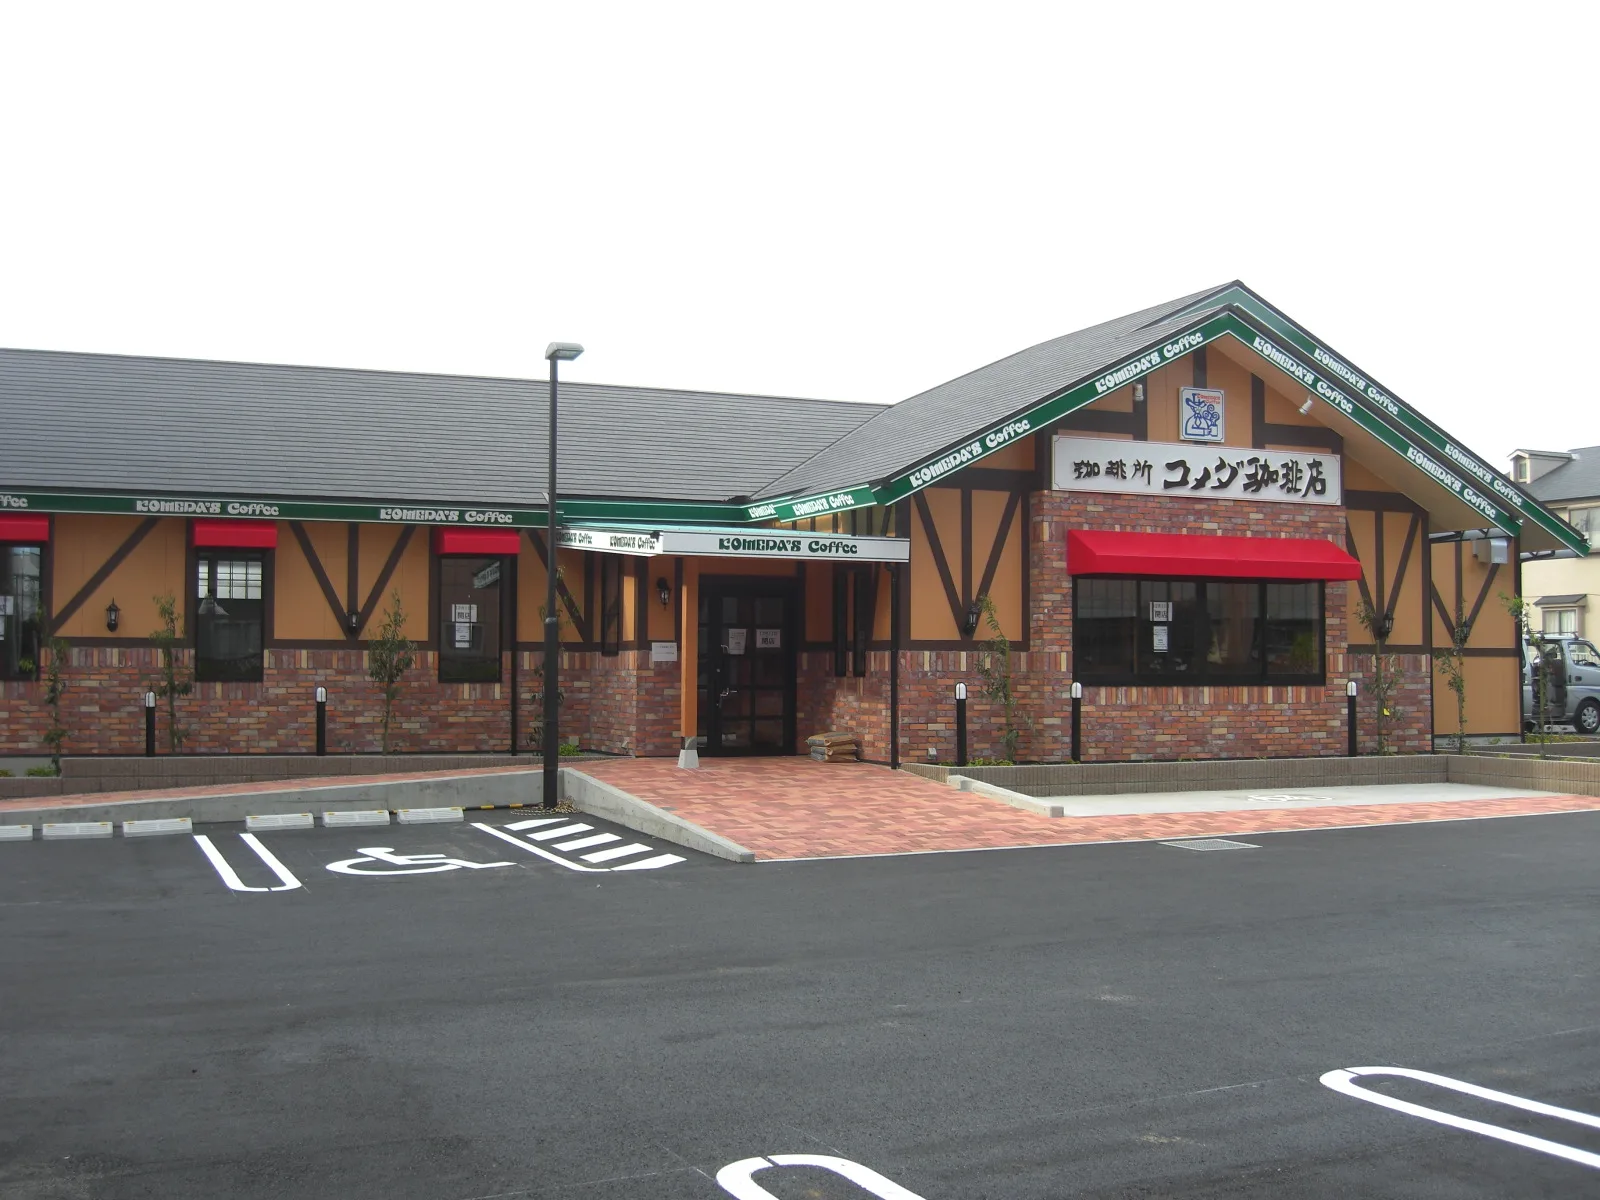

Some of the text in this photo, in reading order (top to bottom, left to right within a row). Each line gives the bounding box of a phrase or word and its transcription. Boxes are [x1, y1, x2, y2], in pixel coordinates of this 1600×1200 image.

[1095, 332, 1204, 393] KOMEDA'S Coffee
[1252, 336, 1354, 413] KOMEDA'S Coffee
[1313, 348, 1399, 415] KOMEDA'S Coffee
[909, 419, 1031, 488] KOMEDA'S Coffee
[1073, 455, 1327, 498] 珈琲所 コメダ珈琲店
[1444, 443, 1523, 506] KOMEDA'S Coffee
[136, 500, 280, 516] KOMEDA'S Coffee
[791, 493, 855, 516] KOMEDA'S Coffee
[1406, 446, 1496, 518] KOMEDA'S Coffee
[379, 508, 513, 523] KOMEDA'S Coffee
[609, 535, 656, 550] KOMEDA'S Coffee
[718, 537, 858, 554] KOMEDA'S Coffee
